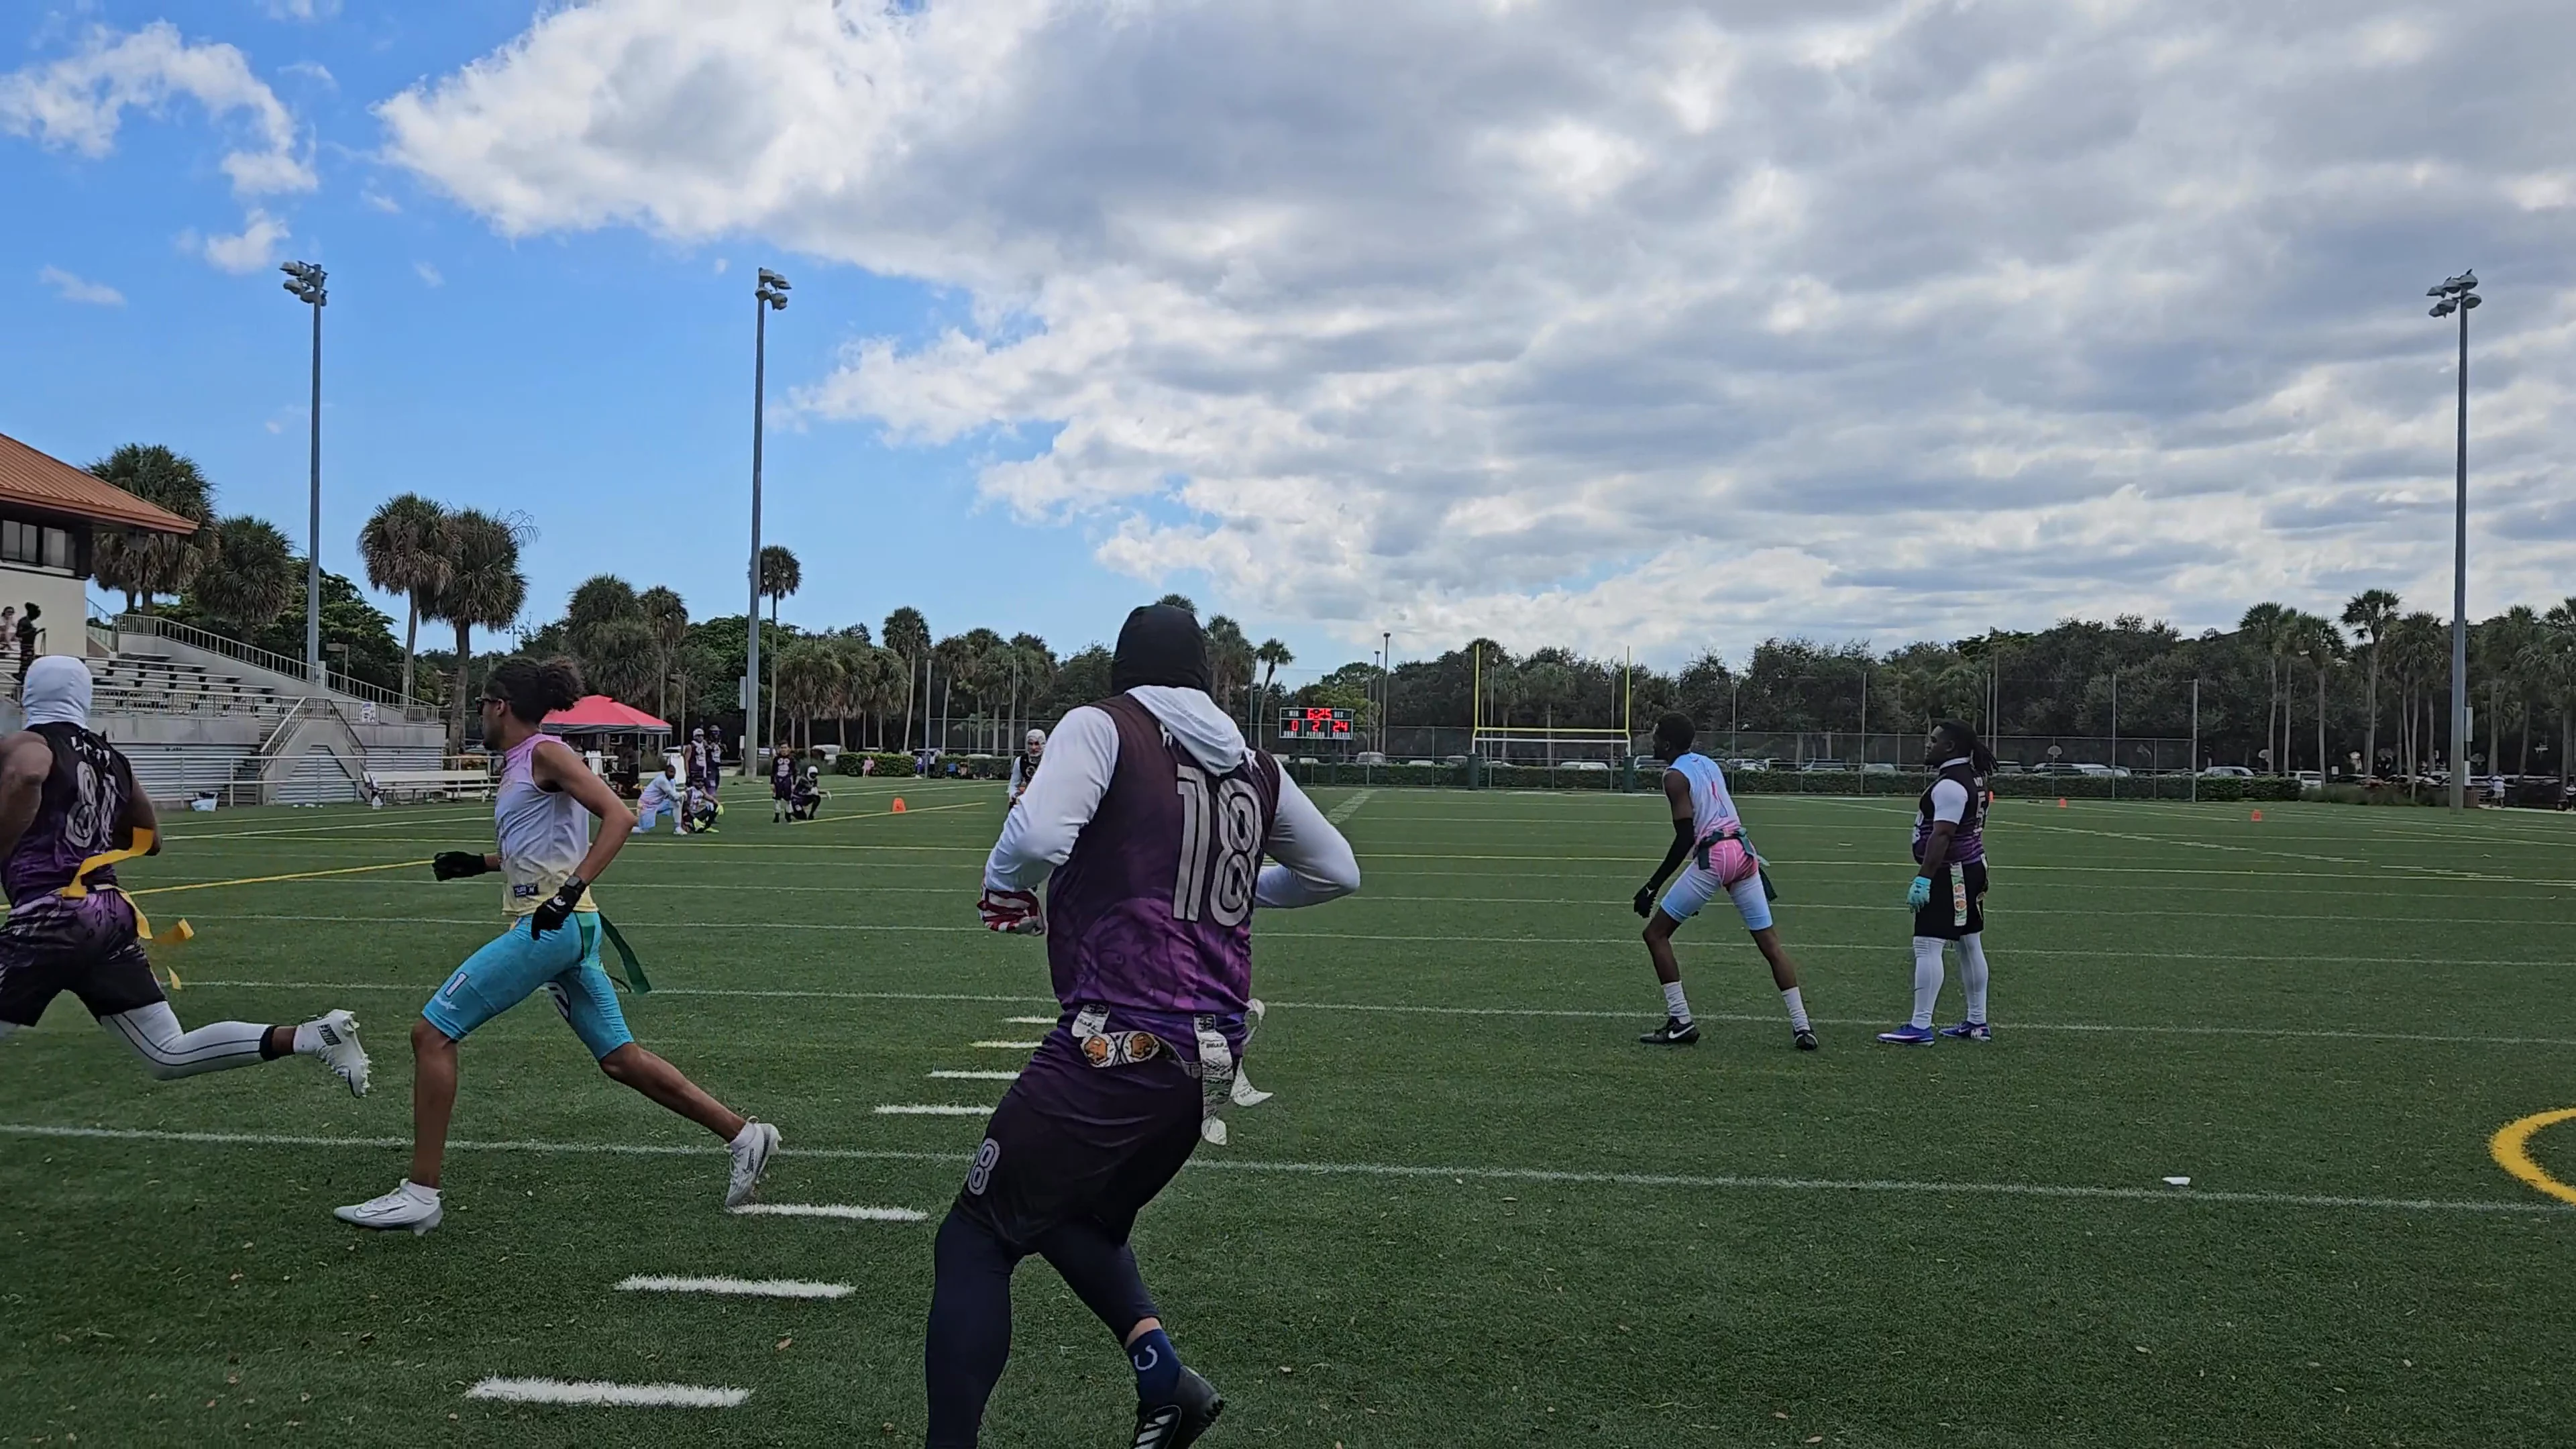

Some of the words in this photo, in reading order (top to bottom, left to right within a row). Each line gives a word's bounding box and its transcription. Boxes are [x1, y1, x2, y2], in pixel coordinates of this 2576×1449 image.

[1307, 708, 1332, 720] 6:25
[1291, 720, 1299, 731] 0
[1312, 720, 1320, 732] 2
[1332, 721, 1348, 732] 24
[1173, 763, 1263, 927] 18
[444, 972, 468, 998] 1
